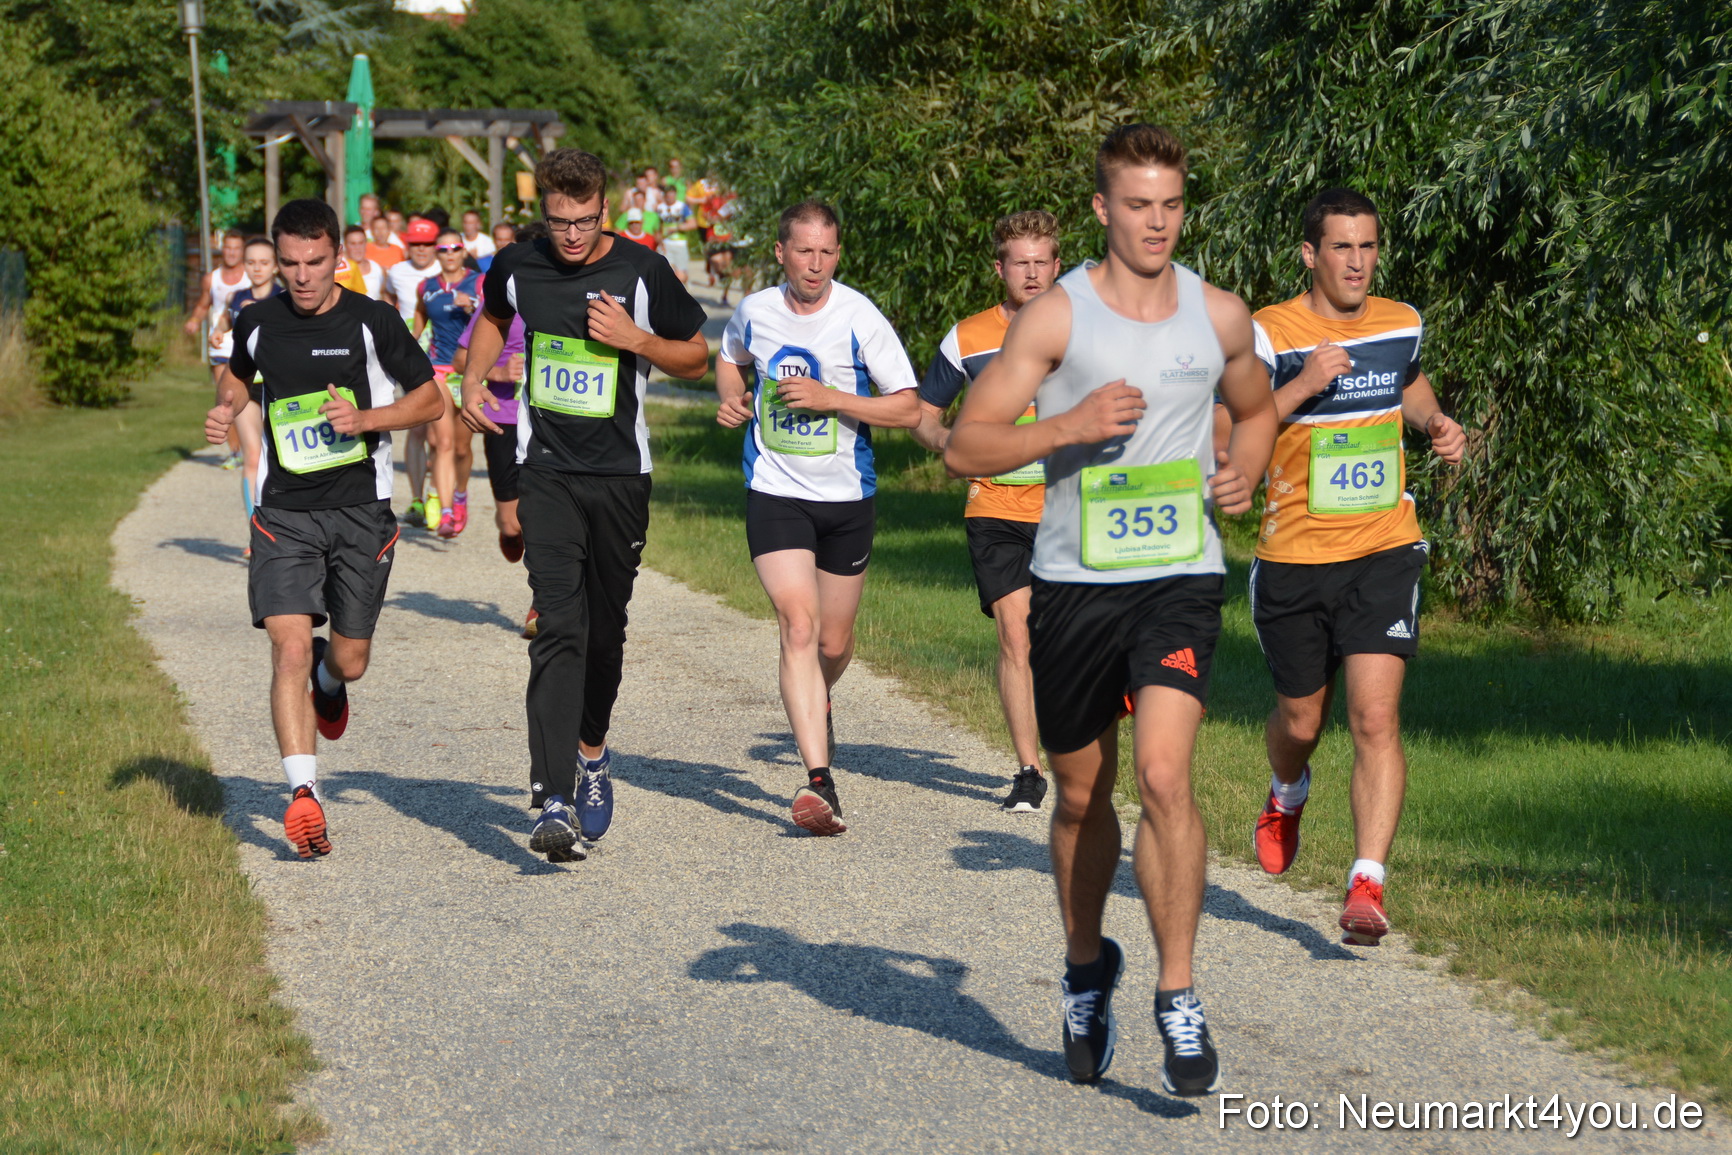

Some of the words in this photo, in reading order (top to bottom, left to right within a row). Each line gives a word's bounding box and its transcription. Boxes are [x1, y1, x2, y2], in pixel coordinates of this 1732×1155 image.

[317, 348, 350, 356] PFLEIDERER
[779, 364, 808, 377] TÜV
[540, 364, 604, 396] 1081
[1337, 370, 1398, 391] ischer
[553, 395, 570, 403] Daniel
[569, 397, 588, 405] Seidler
[1332, 386, 1395, 401] AUTOMOBILE
[768, 409, 829, 436] 1482
[1329, 460, 1385, 490] 463
[1106, 504, 1179, 540] 353
[1114, 545, 1141, 554] Ljubisa
[1141, 543, 1171, 551] Radovic
[1386, 630, 1411, 638] adidas
[1160, 658, 1198, 678] adidas
